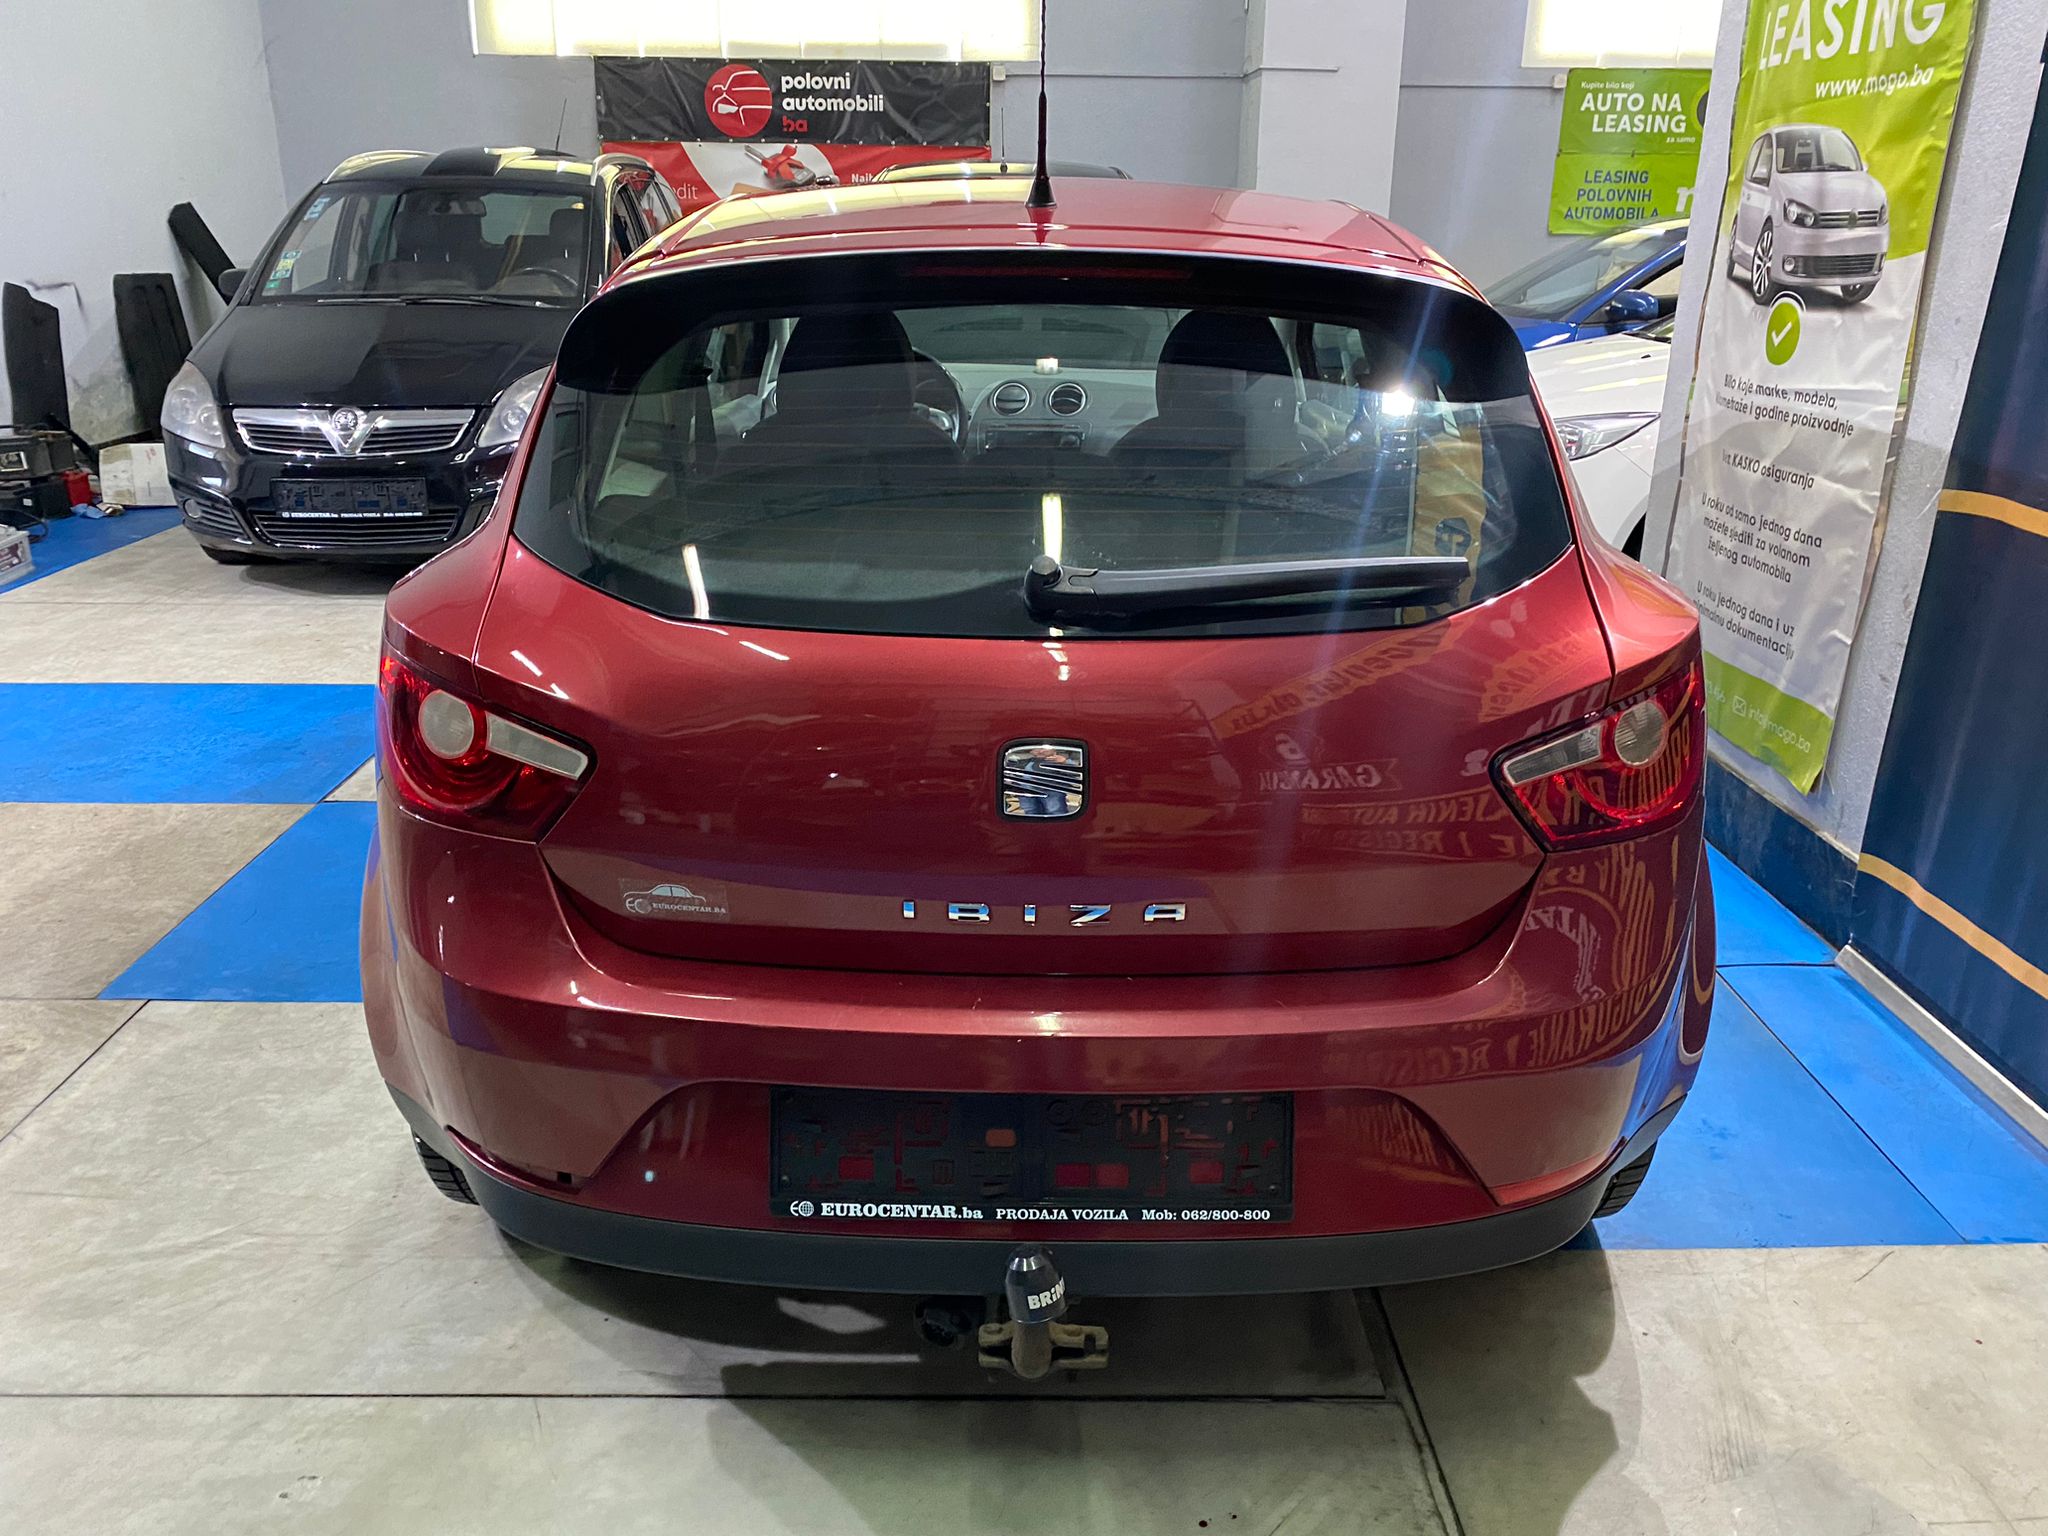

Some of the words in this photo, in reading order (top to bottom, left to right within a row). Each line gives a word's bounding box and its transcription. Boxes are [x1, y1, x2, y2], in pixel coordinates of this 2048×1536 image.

[1759, 0, 1946, 71] LEASING
[781, 72, 851, 93] polovni
[1581, 81, 1604, 90] Kupite
[1815, 64, 1934, 99] www.mogo.ba
[782, 94, 884, 112] automobili
[1580, 92, 1645, 112] AUTO
[1651, 93, 1683, 112] NA
[1592, 114, 1687, 133] LEASING
[673, 182, 699, 200] dit
[1584, 170, 1649, 184] LEASING
[1577, 188, 1652, 202] POLOVNIH
[1564, 206, 1659, 220] AUTOMOBILA
[1737, 377, 1753, 395] koje
[1755, 383, 1790, 402] marke,
[1794, 391, 1838, 410] modela,
[1754, 404, 1790, 422] godine
[1790, 412, 1854, 437] proizvodnje
[1731, 452, 1760, 474] KASKO
[1760, 464, 1815, 490] osiguranja
[1706, 494, 1725, 513] roku
[1734, 508, 1756, 526] samo
[1758, 514, 1791, 542] jednog
[1793, 528, 1823, 548] dana
[1703, 514, 1729, 537] možete
[1755, 537, 1766, 551] za
[1768, 540, 1810, 568] volanom
[1741, 555, 1792, 584] automobila
[1697, 581, 1703, 594] U
[1716, 591, 1747, 620] jednog
[1749, 608, 1773, 630] dana
[1782, 623, 1795, 637] uz
[1726, 617, 1795, 661] dokumentaciju
[902, 899, 1186, 927] IBIZA
[820, 1202, 983, 1220] EUROCENTAR.ba
[996, 1208, 1068, 1222] PRODAJA
[1071, 1208, 1129, 1222] VOZILA
[1141, 1208, 1177, 1222] Mob:
[1181, 1208, 1271, 1223] 062/800-800
